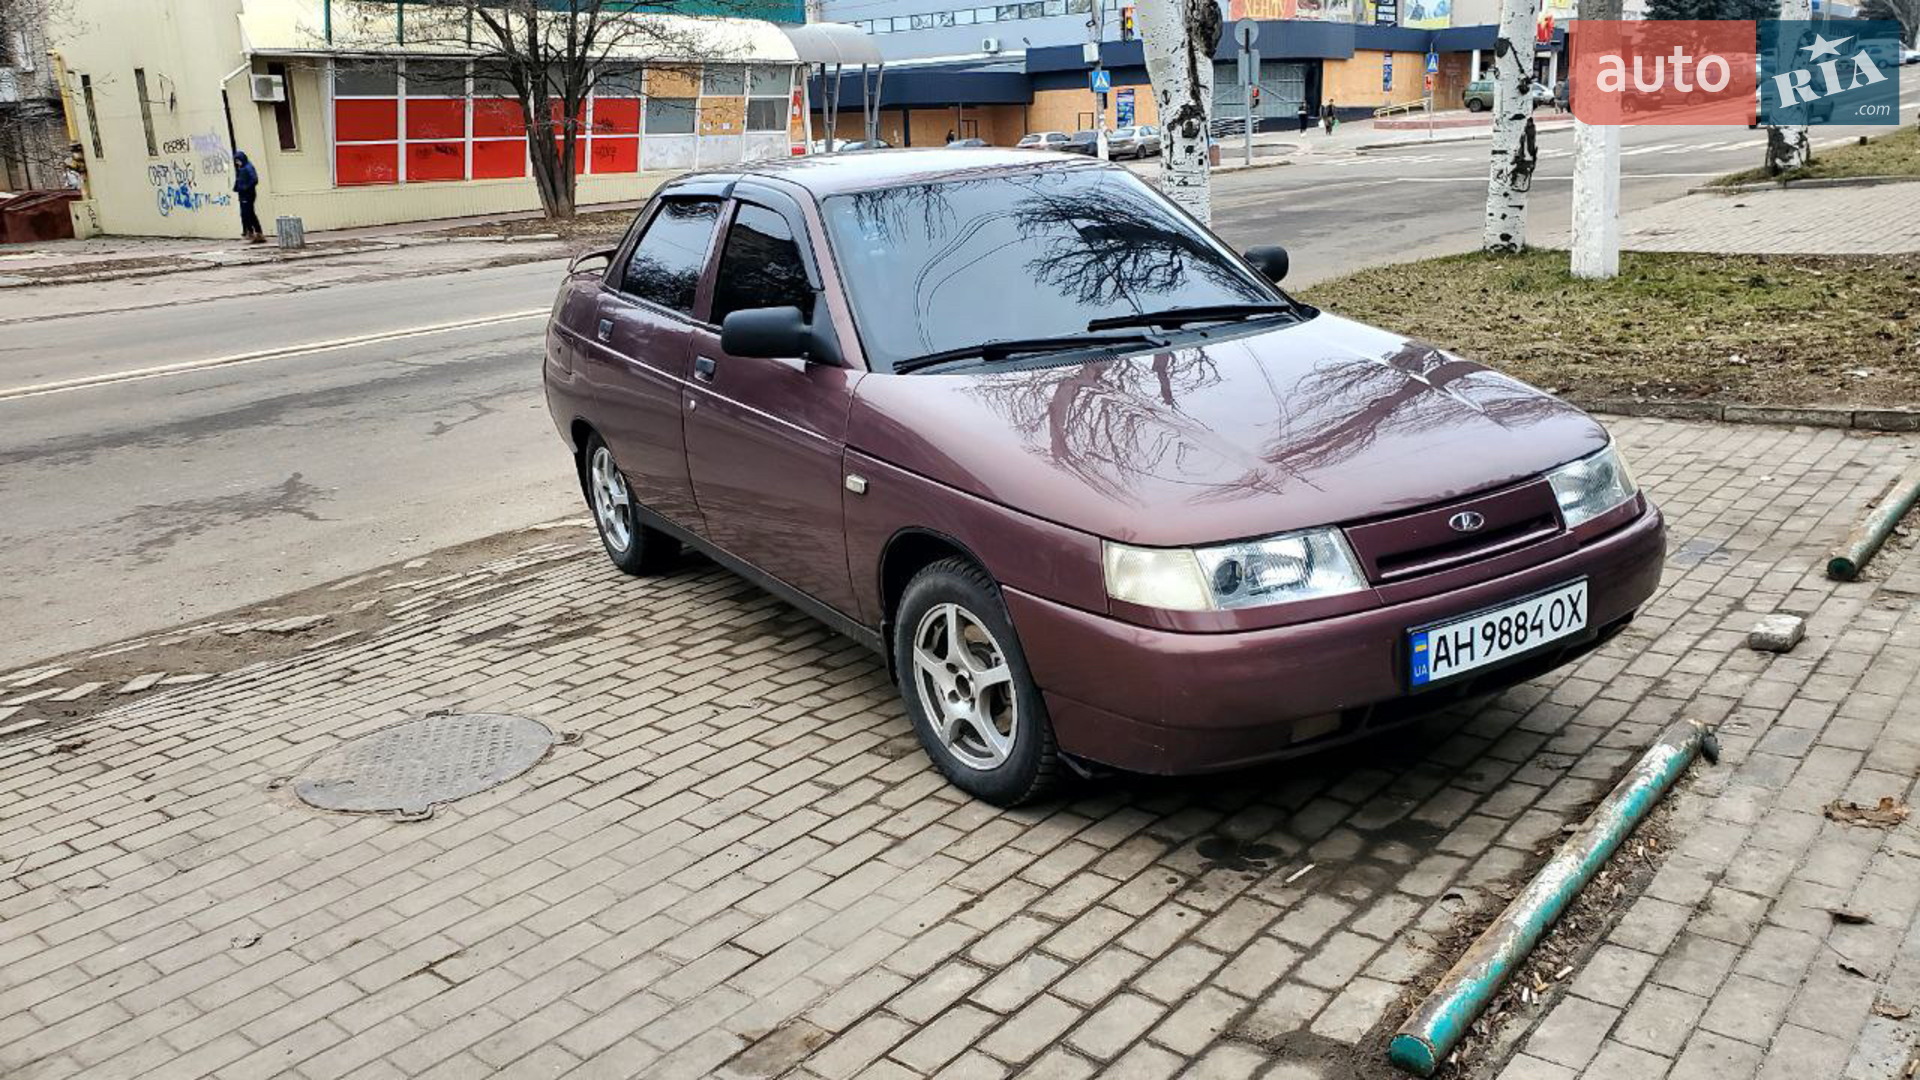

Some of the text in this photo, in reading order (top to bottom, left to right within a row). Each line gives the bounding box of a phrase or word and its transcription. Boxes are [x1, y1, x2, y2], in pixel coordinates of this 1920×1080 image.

[1432, 589, 1583, 673] AH 9884 OX
[1413, 666, 1428, 677] UA
